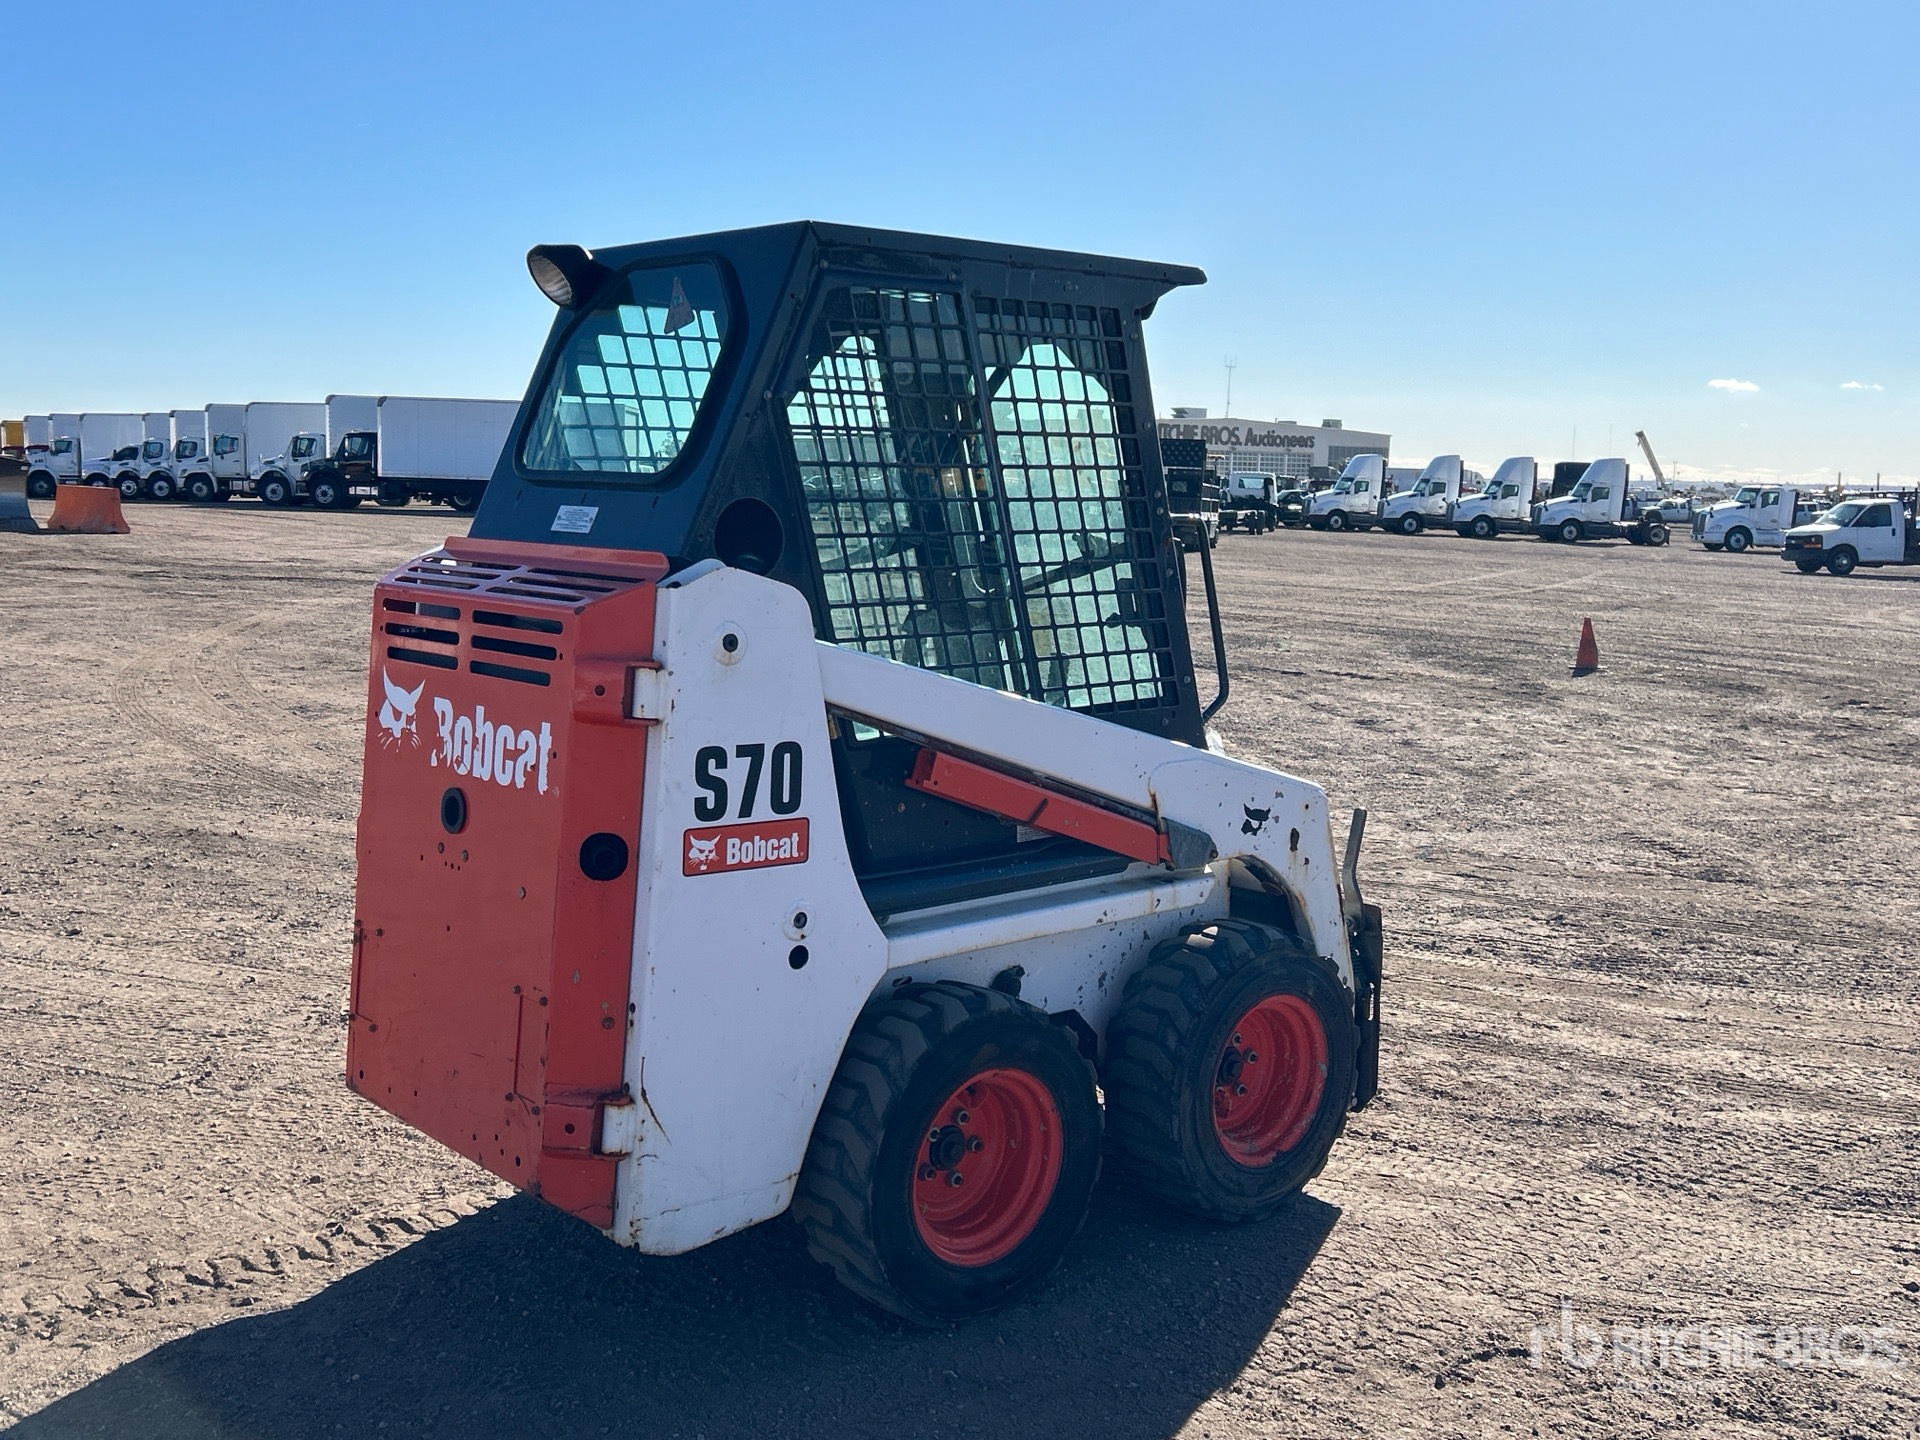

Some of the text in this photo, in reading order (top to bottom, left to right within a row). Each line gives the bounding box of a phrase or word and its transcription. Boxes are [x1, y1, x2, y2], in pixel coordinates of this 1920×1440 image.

[1244, 427, 1316, 449] Auctioneers
[430, 696, 553, 796] Bobcat
[694, 741, 803, 822] S70
[726, 832, 800, 866] Bobcat
